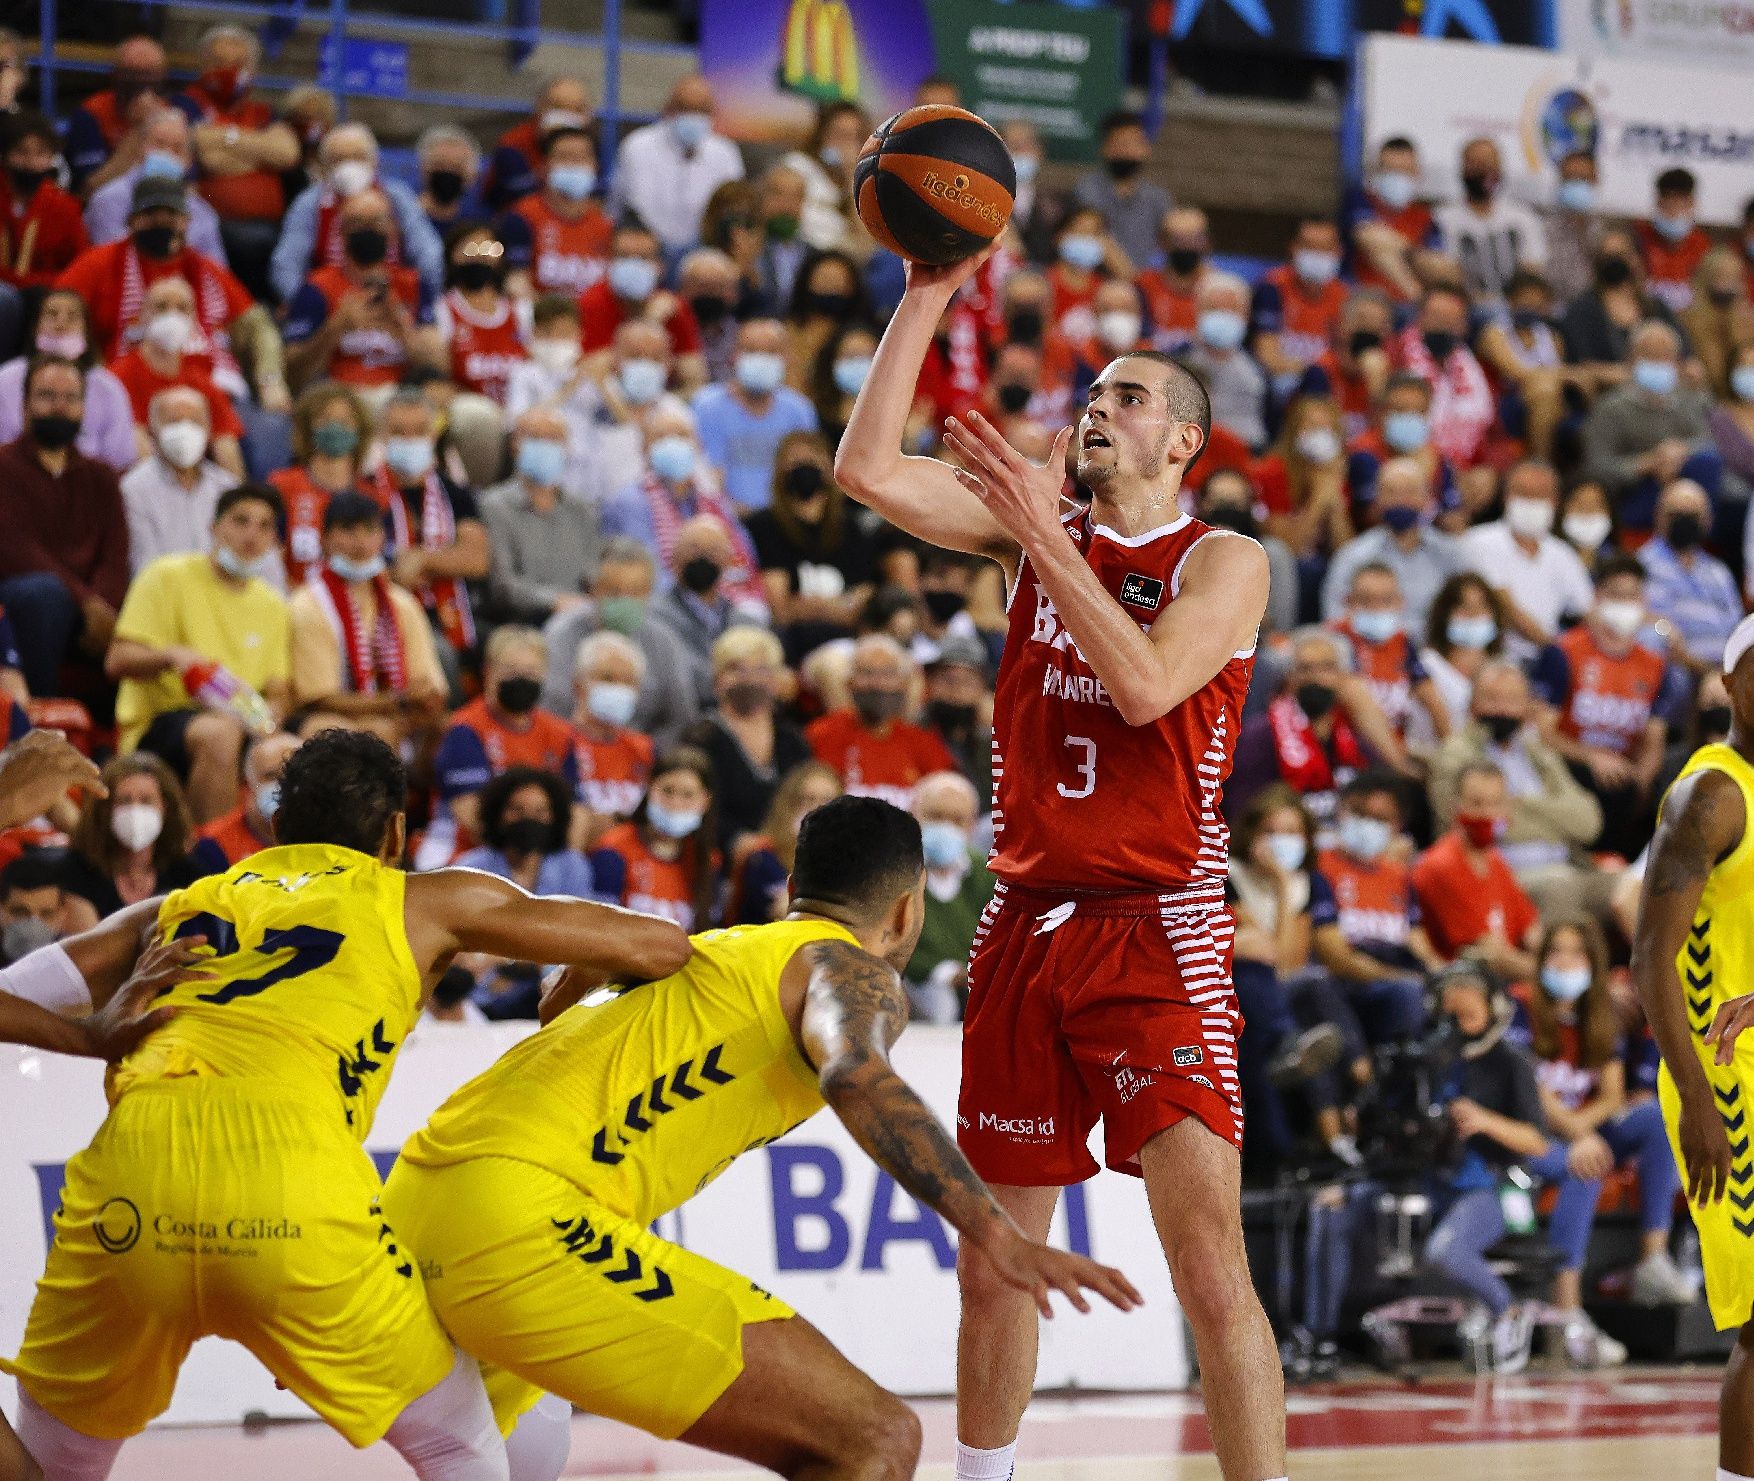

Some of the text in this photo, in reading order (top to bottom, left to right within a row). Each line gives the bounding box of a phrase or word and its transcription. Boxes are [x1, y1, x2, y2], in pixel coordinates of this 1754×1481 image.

[1124, 582, 1156, 606] liga endesa
[1043, 663, 1110, 707] MANRE
[1057, 735, 1096, 799] 3
[979, 1111, 1034, 1135] Macsa
[1038, 1116, 1055, 1136] id
[153, 1214, 302, 1240] Costa Cálida
